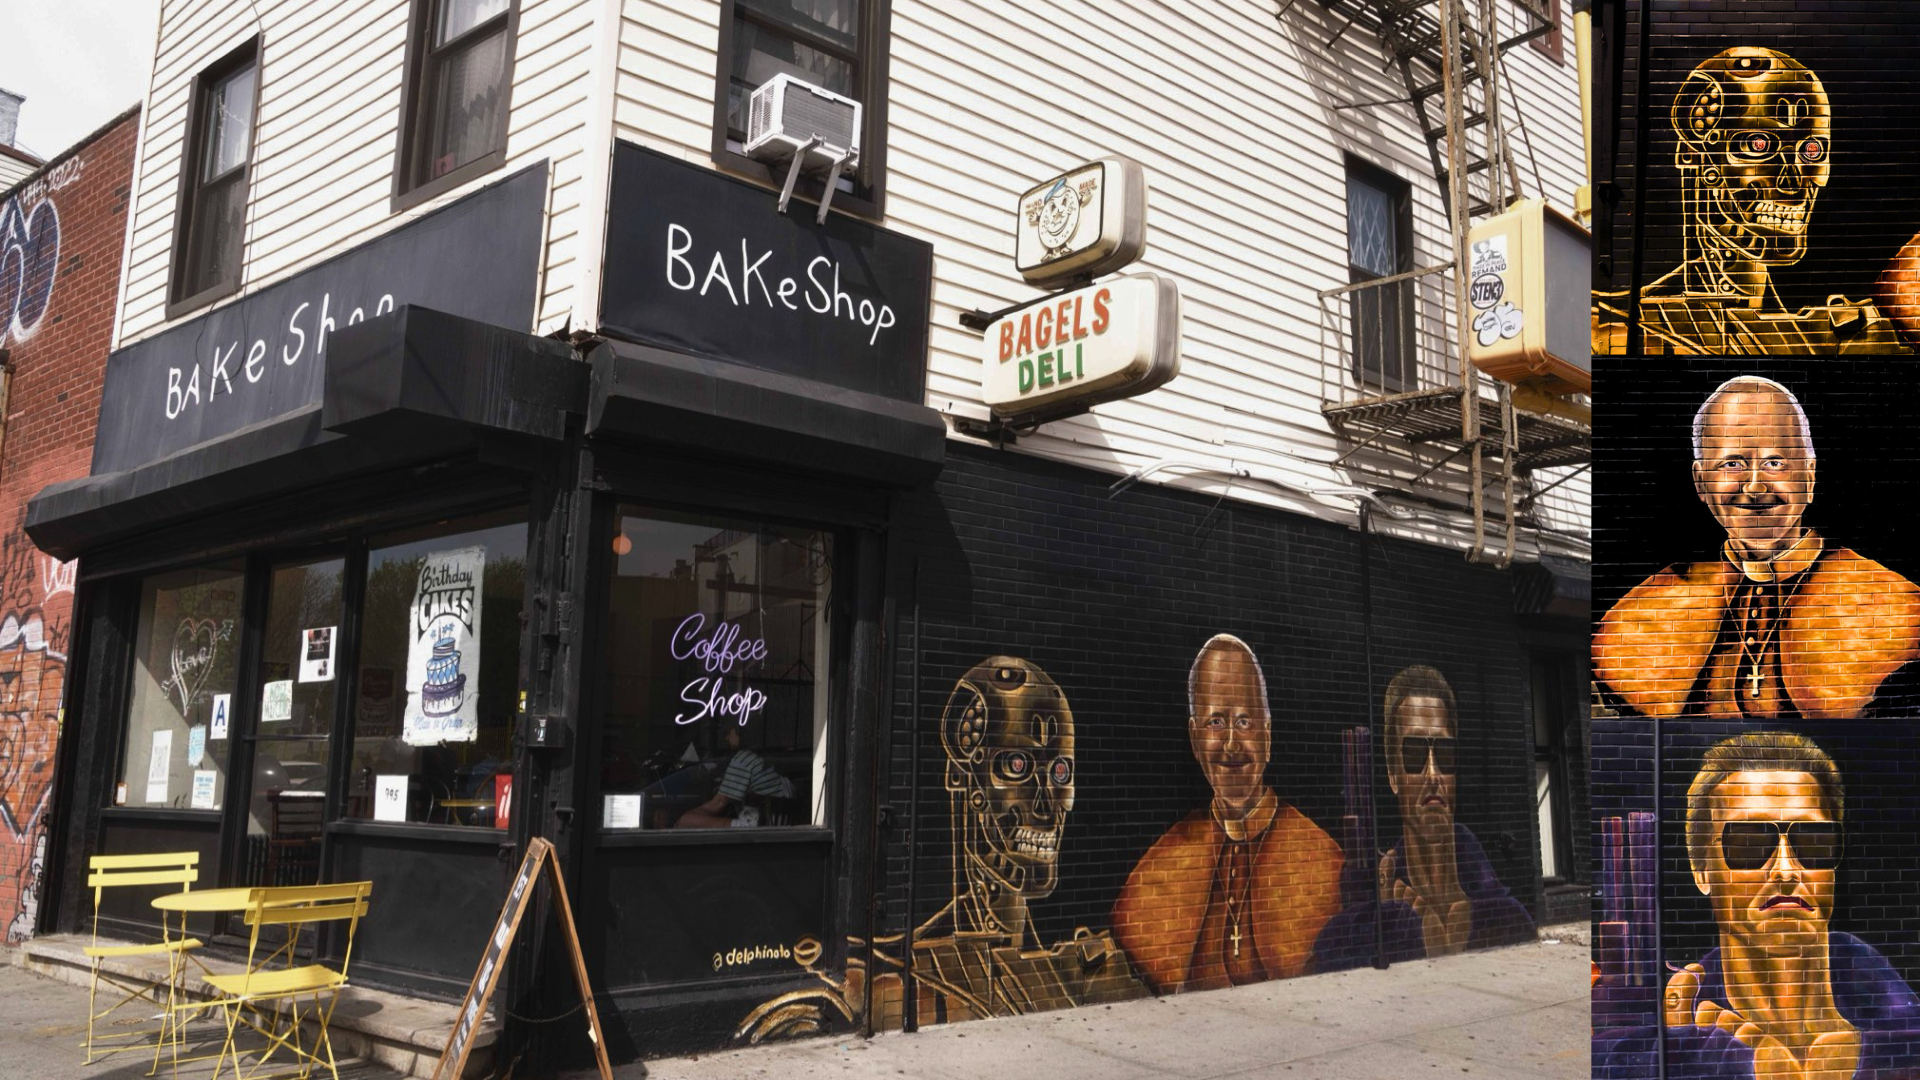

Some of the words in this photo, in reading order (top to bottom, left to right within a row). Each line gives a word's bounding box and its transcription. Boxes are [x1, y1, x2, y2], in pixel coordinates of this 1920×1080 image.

[804, 256, 896, 346] Shop
[999, 287, 1112, 362] BAGELS
[1018, 343, 1086, 394] DELI
[421, 562, 473, 593] Birthday
[420, 589, 473, 632] CAKES
[670, 613, 768, 673] Coffee
[215, 699, 226, 727] A
[675, 677, 768, 727] Shop
